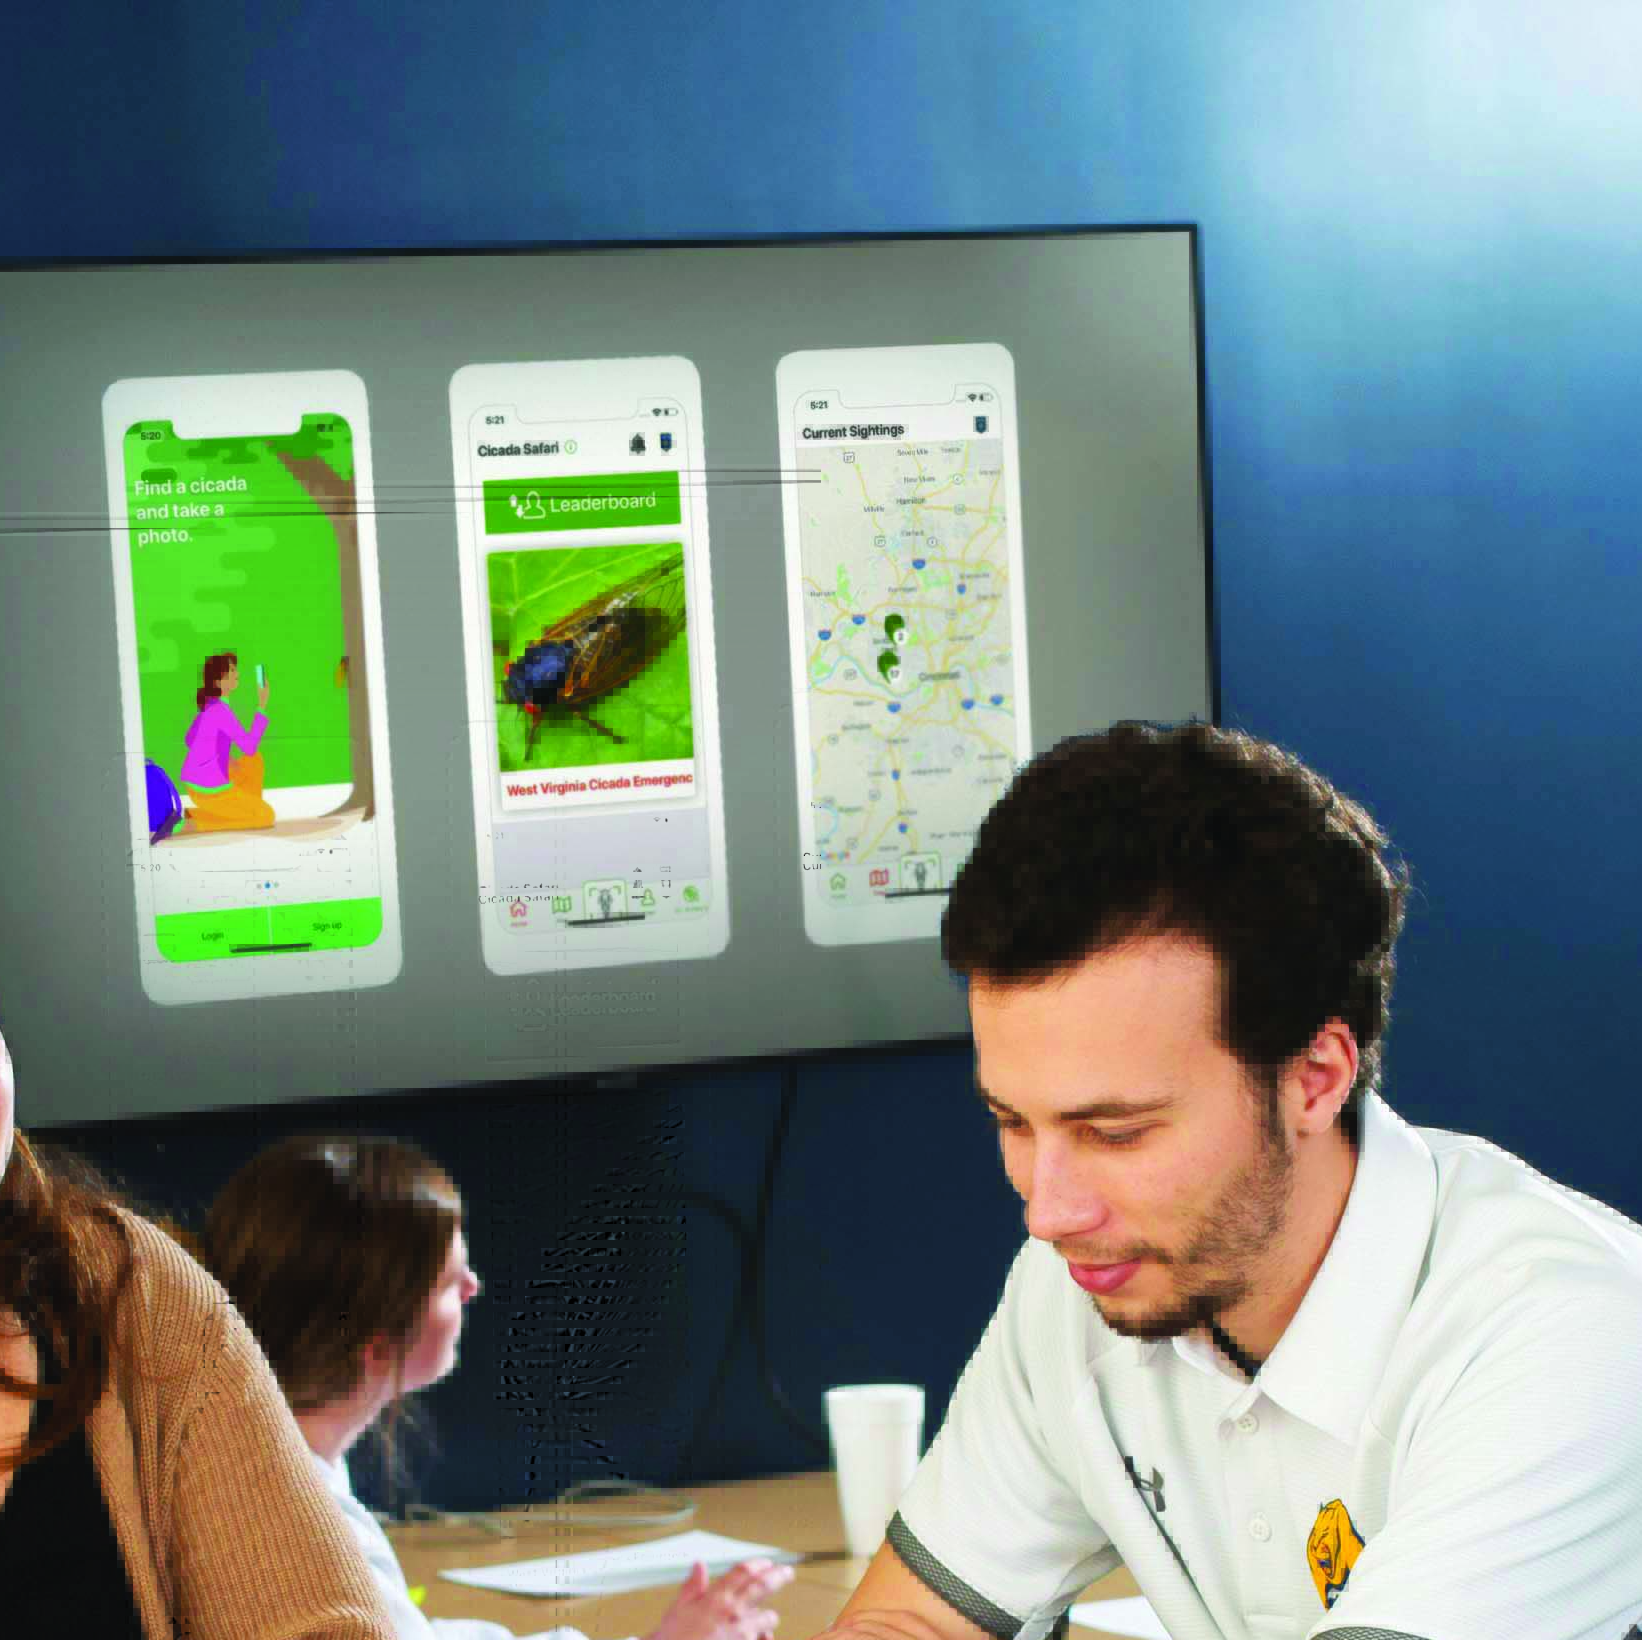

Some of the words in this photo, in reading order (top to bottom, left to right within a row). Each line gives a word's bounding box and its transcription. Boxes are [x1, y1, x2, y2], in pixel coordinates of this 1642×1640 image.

[810, 401, 828, 410] 5:21
[485, 416, 505, 425] 5:21
[802, 427, 848, 440] Current
[849, 424, 905, 440] Sightings
[477, 444, 521, 457] Cicada
[523, 441, 560, 456] Safari
[134, 480, 172, 496] Find
[175, 482, 187, 495] a
[189, 476, 248, 493] cicada
[550, 492, 657, 512] Leaderboard
[136, 504, 169, 520] and
[173, 503, 210, 519] take
[214, 505, 225, 517] a
[137, 528, 194, 548] photo.
[506, 783, 538, 797] West
[540, 780, 587, 796] Virginia
[589, 777, 632, 790] Cicada
[633, 774, 694, 788] Emergenc
[312, 922, 332, 933] Sign
[333, 922, 343, 932] up
[201, 930, 225, 942] Login
